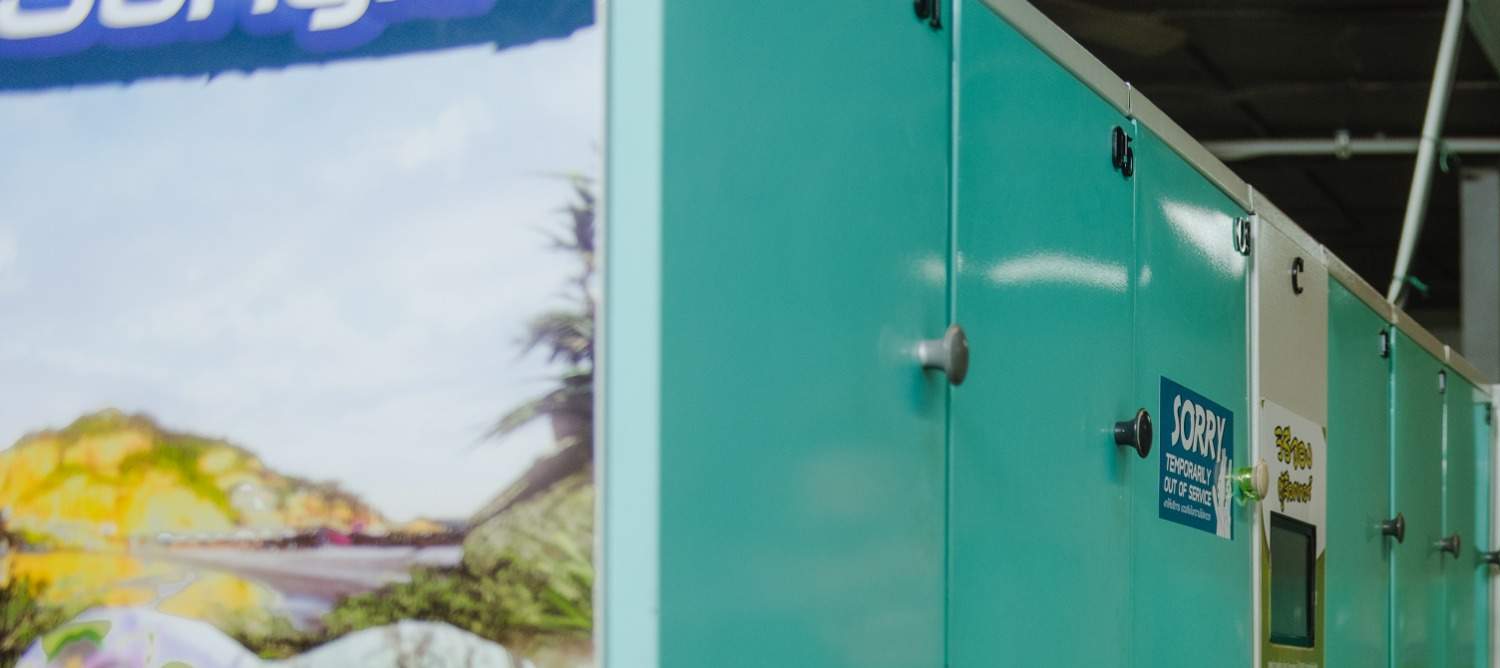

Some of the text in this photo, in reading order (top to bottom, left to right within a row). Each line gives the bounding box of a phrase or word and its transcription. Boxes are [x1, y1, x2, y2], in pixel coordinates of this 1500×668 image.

[1291, 256, 1304, 295] C
[1171, 394, 1226, 462] SORRY
[1166, 452, 1212, 485] TEMPORARILY
[1164, 475, 1212, 507] OUT OF SERVICE
